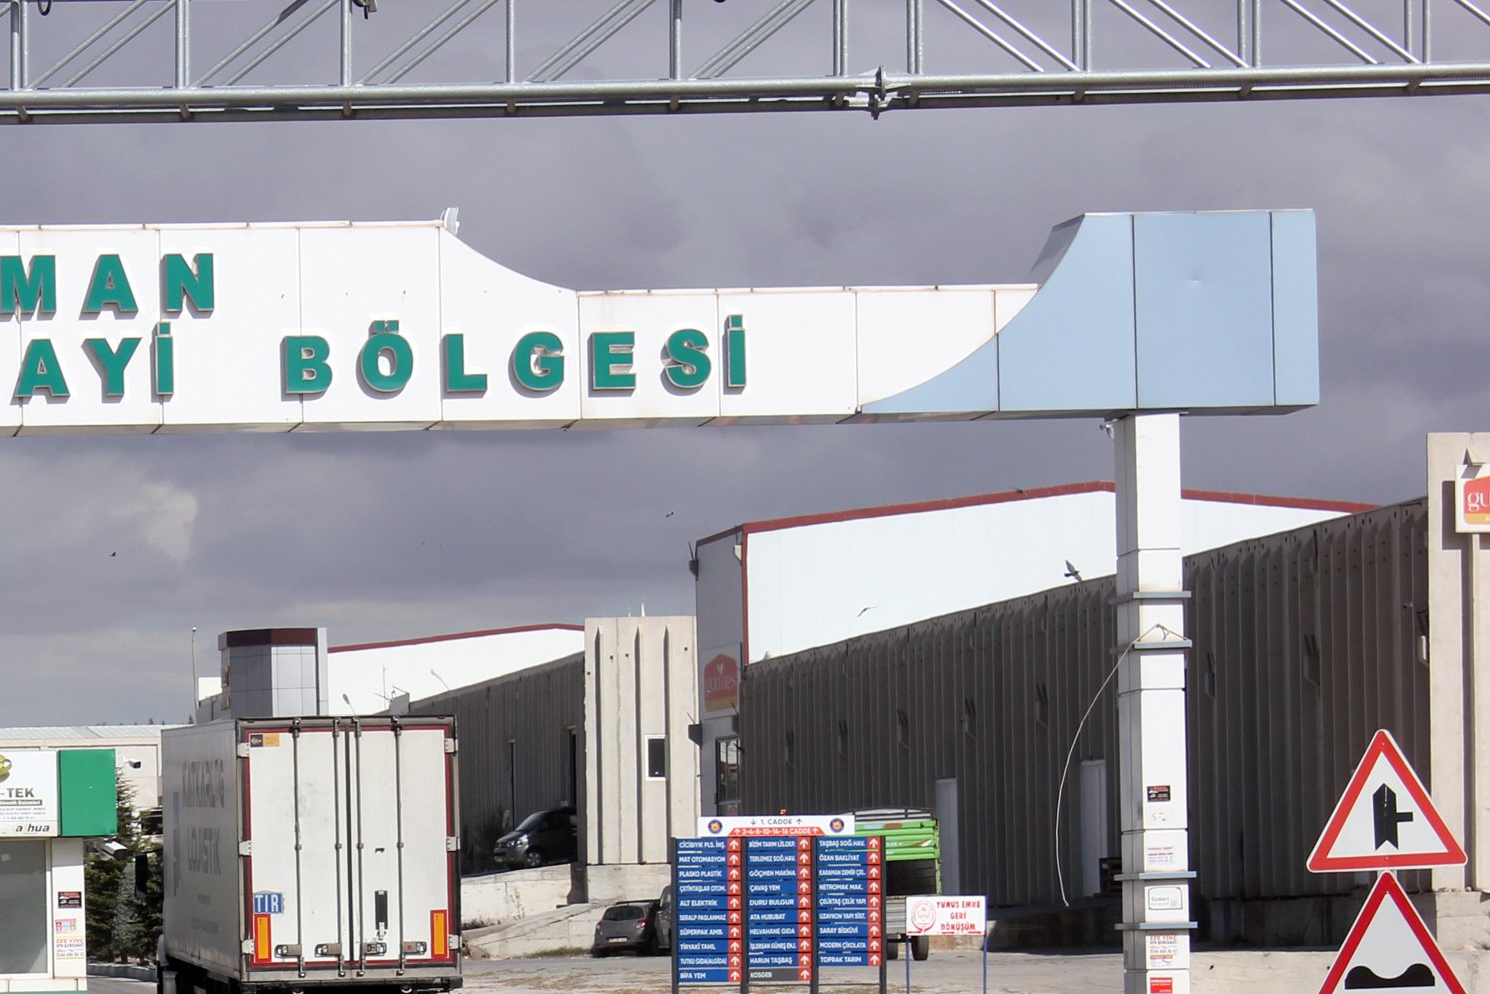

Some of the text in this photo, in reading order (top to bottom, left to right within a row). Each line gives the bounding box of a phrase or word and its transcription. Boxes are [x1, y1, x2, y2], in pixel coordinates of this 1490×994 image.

[280, 314, 747, 398] BÖLGESİ
[819, 840, 839, 848] TAŞBAŞ
[835, 853, 860, 861] BAKLİYAT
[701, 869, 722, 877] PLASTİK
[749, 869, 796, 878] GÖÇMEN MAKİNA
[750, 884, 768, 893] ÇAVAŞ
[255, 894, 279, 913] TIR
[691, 898, 718, 907] ELEKTRİK
[819, 897, 841, 906] ÇELİKTAŞ
[936, 900, 981, 908] YUNUS EMRE
[950, 910, 967, 920] GERİ
[838, 926, 858, 934] BİSKÜVİ
[940, 921, 976, 933] DÖNÜŞÜM
[679, 928, 709, 936] SÜPERPAK
[771, 942, 786, 950] GÜNEŞ
[842, 941, 867, 949] ÇİKOLATA
[771, 957, 793, 965] TAŞBAŞ
[679, 971, 693, 979] BİFA
